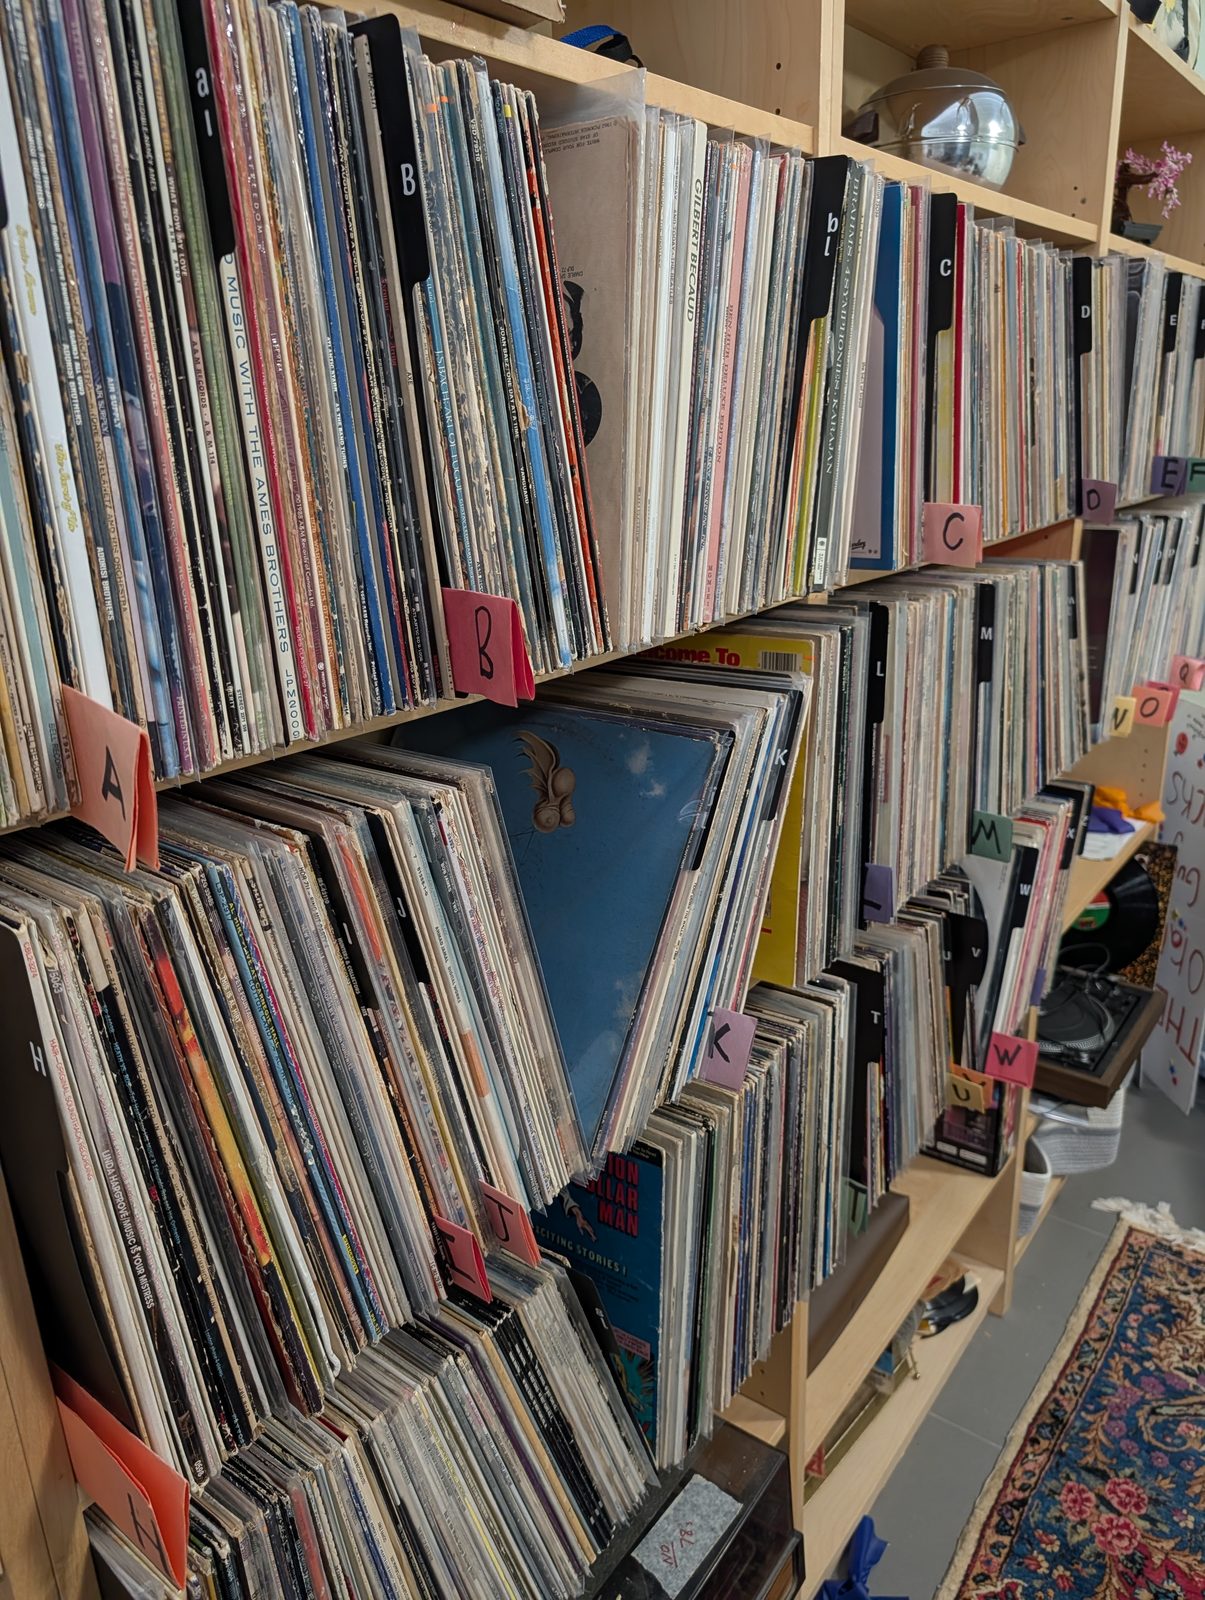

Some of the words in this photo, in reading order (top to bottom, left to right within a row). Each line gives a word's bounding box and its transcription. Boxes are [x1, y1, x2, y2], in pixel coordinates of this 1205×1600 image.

[336, 141, 344, 161] JAN
[165, 176, 178, 205] WHAT
[339, 164, 350, 205] AUGUST
[401, 163, 416, 196] B
[170, 207, 182, 230] NOW
[344, 208, 353, 237] PLAYS
[691, 178, 701, 245] GILBERT
[845, 177, 860, 257] BRAHMS
[174, 232, 185, 249] MY
[178, 252, 189, 276] LOVE
[939, 258, 952, 278] C
[687, 251, 698, 322] BECAUD
[226, 275, 245, 349] MUSIC
[1081, 305, 1091, 319] D
[1170, 314, 1178, 326] E
[498, 326, 506, 346] JOAN
[722, 304, 735, 359] BEN-HUR
[833, 276, 853, 390] SYMPHONIES
[362, 343, 373, 387] POPULAR
[505, 371, 513, 387] ONE
[238, 359, 255, 416] WITH
[507, 388, 515, 403] DAY
[718, 361, 730, 410] DELUXE
[195, 368, 207, 409] RECORDS
[207, 451, 215, 464] 114
[326, 336, 335, 368] ATLANTIC
[339, 445, 347, 468] TURNS
[512, 421, 520, 438] TIME
[714, 414, 726, 463] EDITION
[824, 398, 840, 474] KARAJAN
[248, 425, 263, 467] THE
[519, 466, 529, 504] VANGUARD
[1160, 457, 1179, 490] E
[255, 476, 273, 535] AMES
[384, 492, 393, 533] MERCURY
[1086, 489, 1101, 511] D
[297, 521, 306, 536] A&M
[942, 512, 965, 552] C
[299, 537, 310, 564] Records
[304, 571, 314, 595] Canada
[101, 580, 115, 620] BROTHERS
[265, 544, 289, 652] BROTHERS
[308, 596, 316, 608] Ltd.
[475, 606, 493, 680] B
[980, 626, 993, 640] M
[715, 647, 741, 667] To
[876, 661, 885, 678] L
[225, 682, 235, 708] LIBERTY
[236, 688, 244, 711] STEREO
[1140, 696, 1160, 718] O
[775, 748, 788, 766] K
[100, 744, 127, 822] A
[973, 819, 1001, 854] M
[1066, 826, 1075, 839] X
[443, 875, 452, 892] JAMES
[1020, 882, 1031, 897] W
[396, 896, 406, 918] J
[299, 923, 310, 940] NEW
[304, 940, 322, 975] RECORDINGS
[972, 947, 981, 958] V
[346, 964, 360, 995] COLLECTORS
[220, 975, 229, 990] THIS
[231, 1009, 240, 1022] HIRT
[320, 985, 332, 1007] CHOPIN
[254, 982, 272, 1023] CARNEGIE
[269, 1026, 280, 1047] HALL
[871, 1010, 881, 1024] T
[112, 1042, 124, 1062] HEATH
[709, 1022, 733, 1064] K
[993, 1043, 1022, 1067] W
[30, 1041, 47, 1077] H
[952, 1083, 970, 1102] U
[64, 1095, 83, 1143] SOUNDTRACK
[77, 1142, 94, 1180] RECORDING
[97, 1150, 113, 1176] LINDA
[587, 1177, 639, 1211] OLLAR
[484, 1191, 514, 1242] J
[598, 1201, 639, 1237] MAN
[126, 1245, 137, 1255] IS
[128, 1253, 143, 1276] YOUR
[135, 1274, 153, 1309] MISTRESS
[127, 1492, 173, 1580] H
